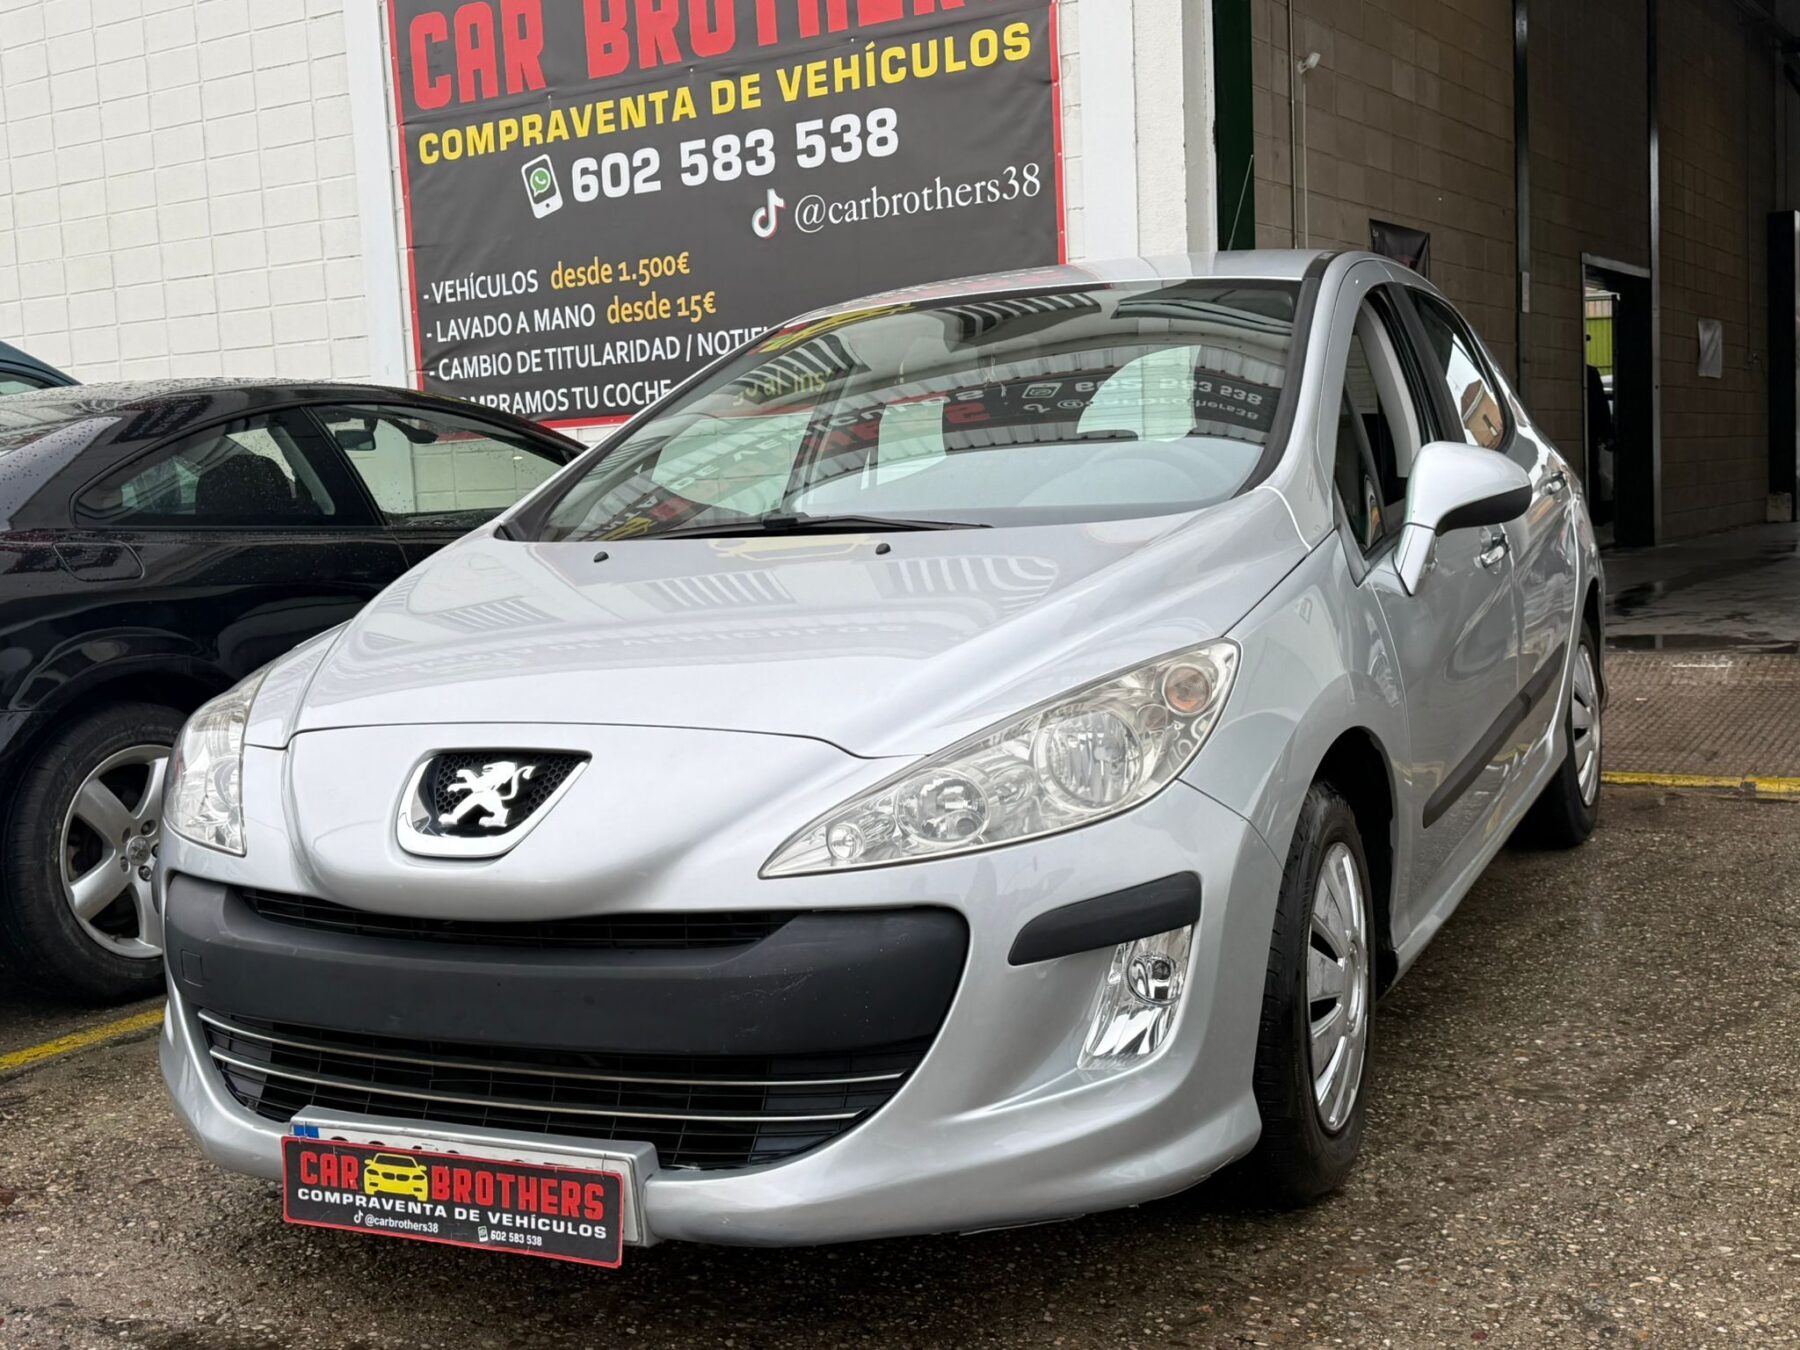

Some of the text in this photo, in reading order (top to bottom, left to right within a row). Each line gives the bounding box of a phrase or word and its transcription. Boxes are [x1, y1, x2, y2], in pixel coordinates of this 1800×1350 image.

[410, 0, 547, 110] CAR
[419, 86, 697, 165] COMPRAVENTA
[711, 73, 761, 114] DE
[776, 22, 1031, 102] VEHÍCULOS
[572, 107, 899, 202] 602 583 538
[795, 163, 1041, 233] @carbrothers38
[550, 256, 613, 290] desde
[618, 252, 690, 287] 1.500€
[436, 312, 512, 342] LAVADO
[516, 311, 530, 334] A
[533, 303, 596, 332] MANO
[607, 291, 671, 324] desde
[676, 291, 716, 323] 15€
[438, 353, 512, 381] CAMBIO
[517, 349, 543, 374] DE
[544, 336, 680, 371] TITULARIDAD
[572, 386, 598, 410] TU
[300, 1151, 605, 1221] CAR BROTHERS
[298, 1188, 607, 1239] COMPRAVENTA DE VEHÍCULOS
[365, 1214, 438, 1234] @carbrothers38
[490, 1230, 542, 1246] 602 583 538
